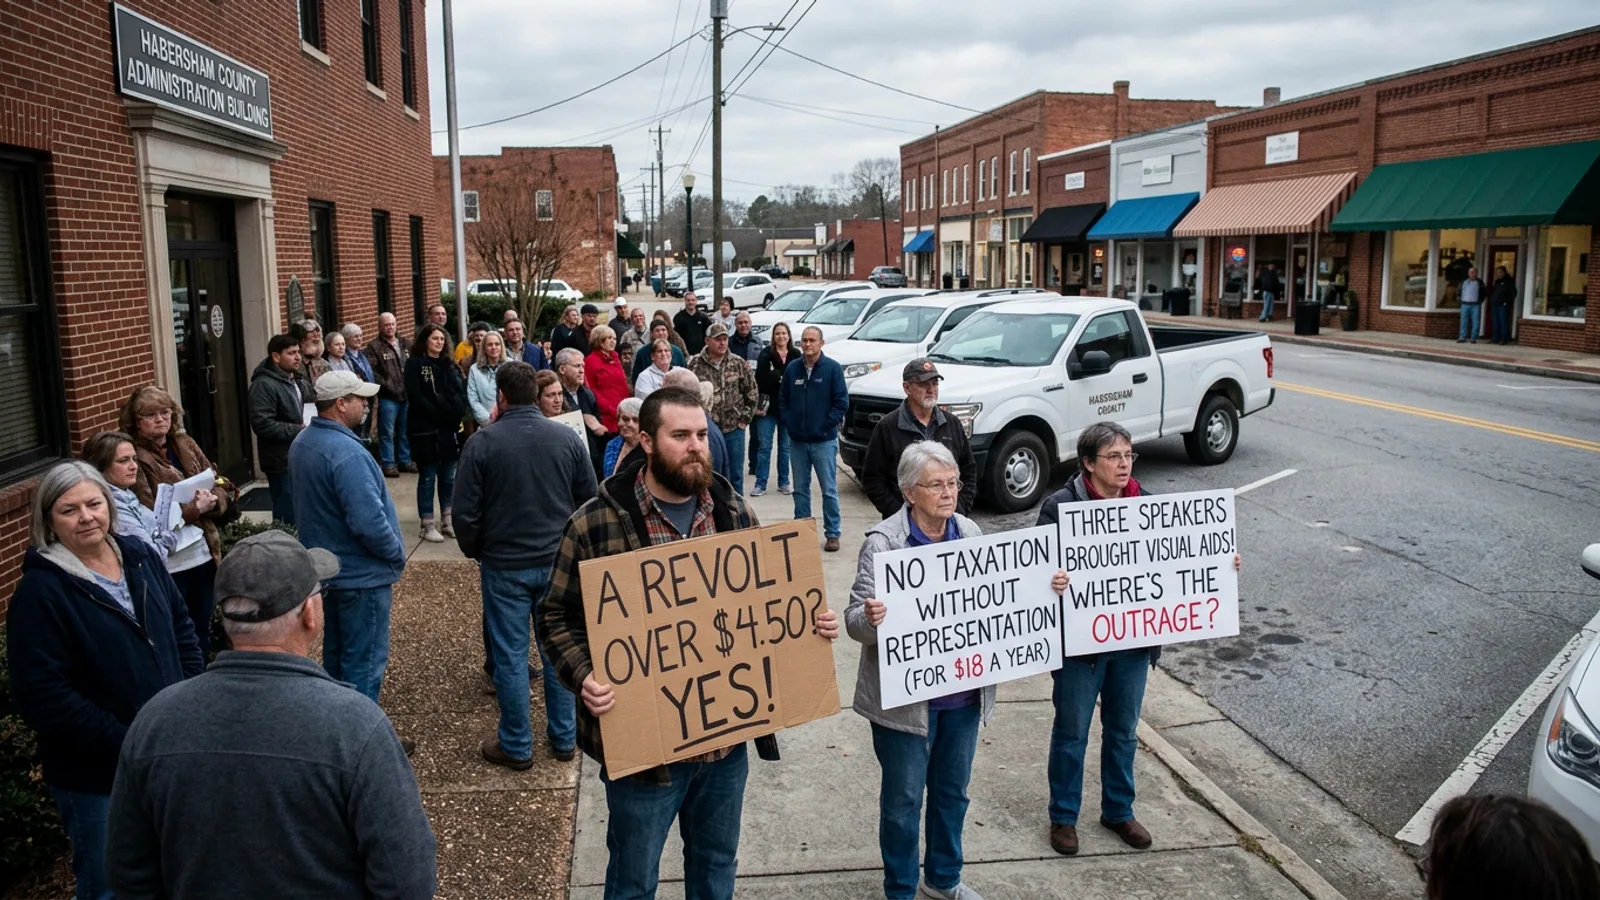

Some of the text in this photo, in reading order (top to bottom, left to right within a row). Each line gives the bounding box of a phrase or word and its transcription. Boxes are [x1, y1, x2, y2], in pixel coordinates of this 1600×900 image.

[140, 28, 257, 97] HABERSHAM COUNTY
[127, 57, 269, 128] ADMINISTRATION BUILDING
[1065, 497, 1227, 537] THREE SPEAKERS
[597, 531, 799, 625] A REVOLT
[885, 535, 1050, 593] NO TAXATION
[1066, 528, 1235, 572] BROUGHT VISUAL AIDS!
[915, 577, 1020, 622] WITHOUT
[1068, 566, 1219, 610] WHERE'S THE
[604, 588, 823, 686] OVER $4.50?
[886, 603, 1057, 666] REPRESENTATION
[1092, 597, 1220, 644] OUTRAGE?
[904, 637, 1051, 696] (FOR $18 A YEAR)
[661, 655, 776, 741] YES!
